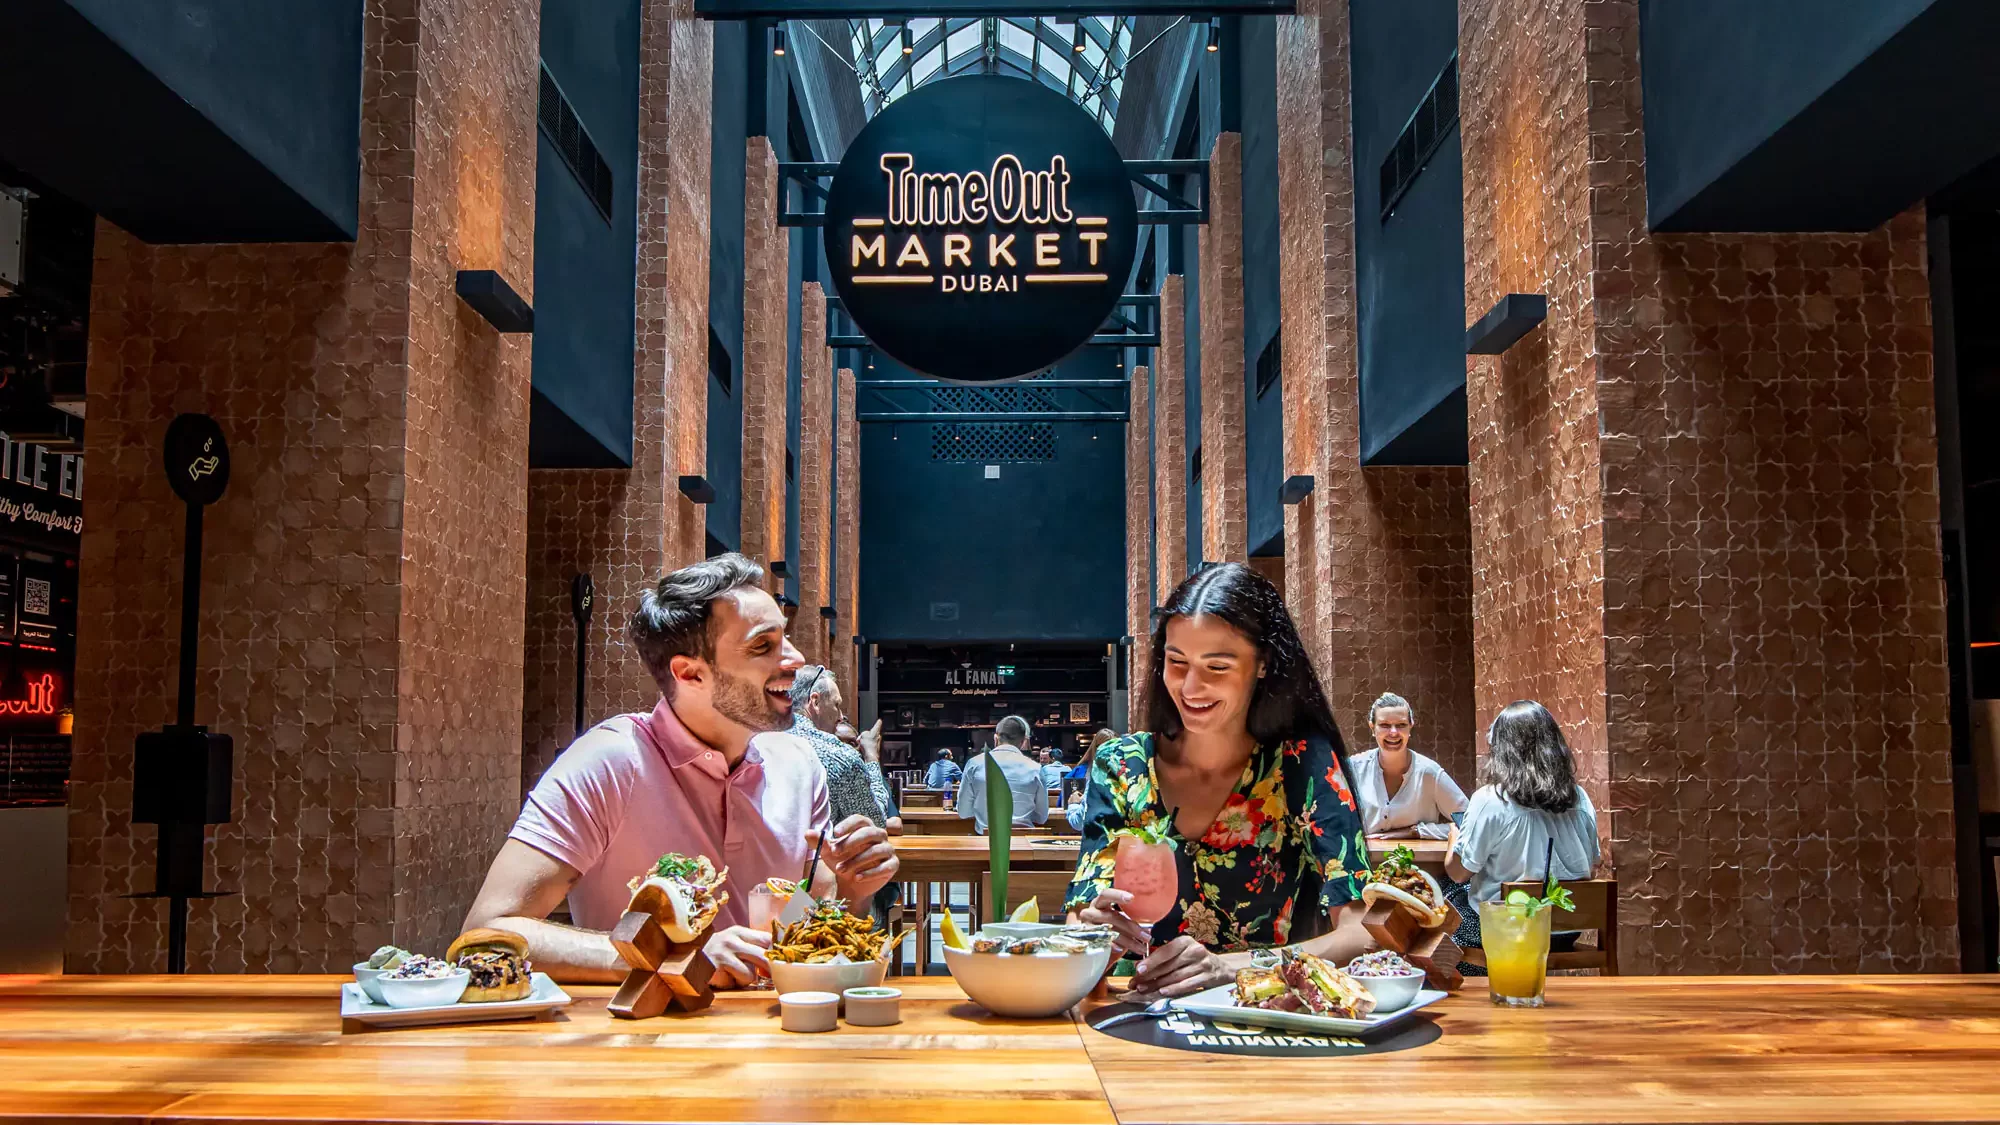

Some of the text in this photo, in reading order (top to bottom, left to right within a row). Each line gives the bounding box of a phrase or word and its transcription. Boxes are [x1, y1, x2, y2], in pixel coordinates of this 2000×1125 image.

[880, 153, 1073, 225] Time Out
[852, 232, 1108, 267] MARKET
[942, 275, 1018, 292] DUBAI
[0, 496, 21, 523] thy
[22, 502, 73, 532] Comfort
[945, 670, 960, 684] AL
[1187, 1035, 1366, 1047] MAXIMUM
